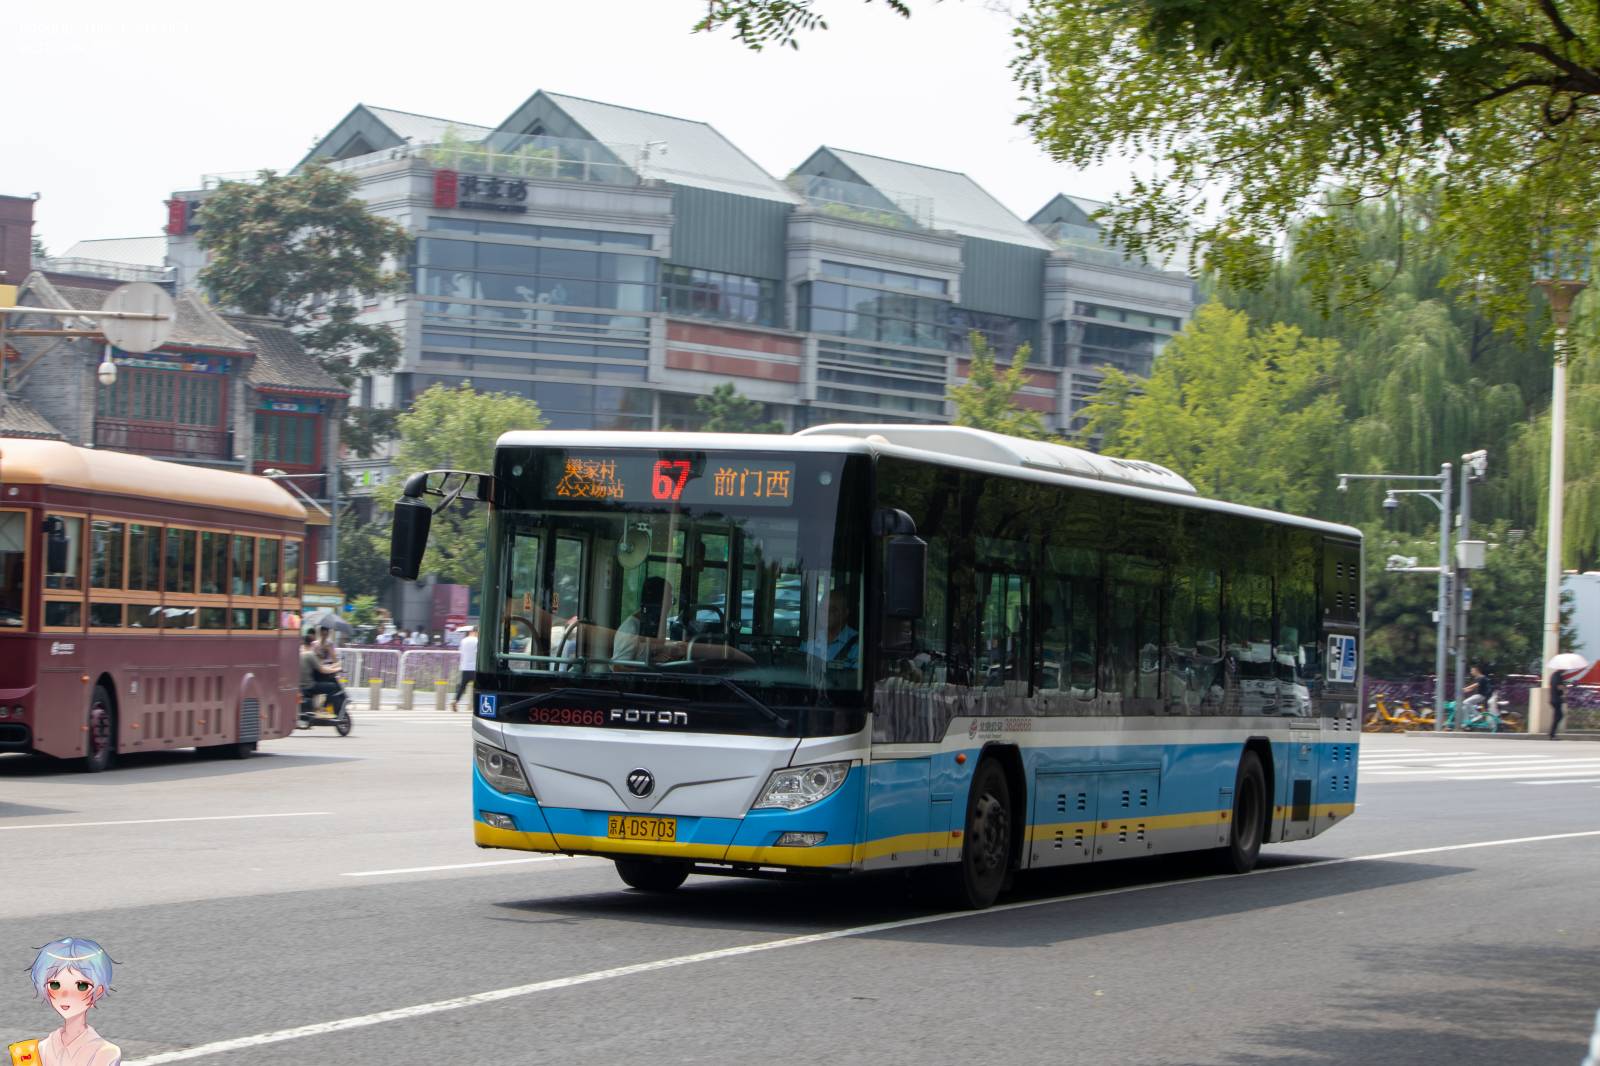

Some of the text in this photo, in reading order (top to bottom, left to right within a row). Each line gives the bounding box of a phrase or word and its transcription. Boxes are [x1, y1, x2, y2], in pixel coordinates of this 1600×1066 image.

[555, 479, 625, 499] 公交场站
[651, 459, 692, 500] 67
[713, 467, 793, 499] 前门西
[528, 707, 604, 725] 3629666
[610, 708, 688, 725] FOTON
